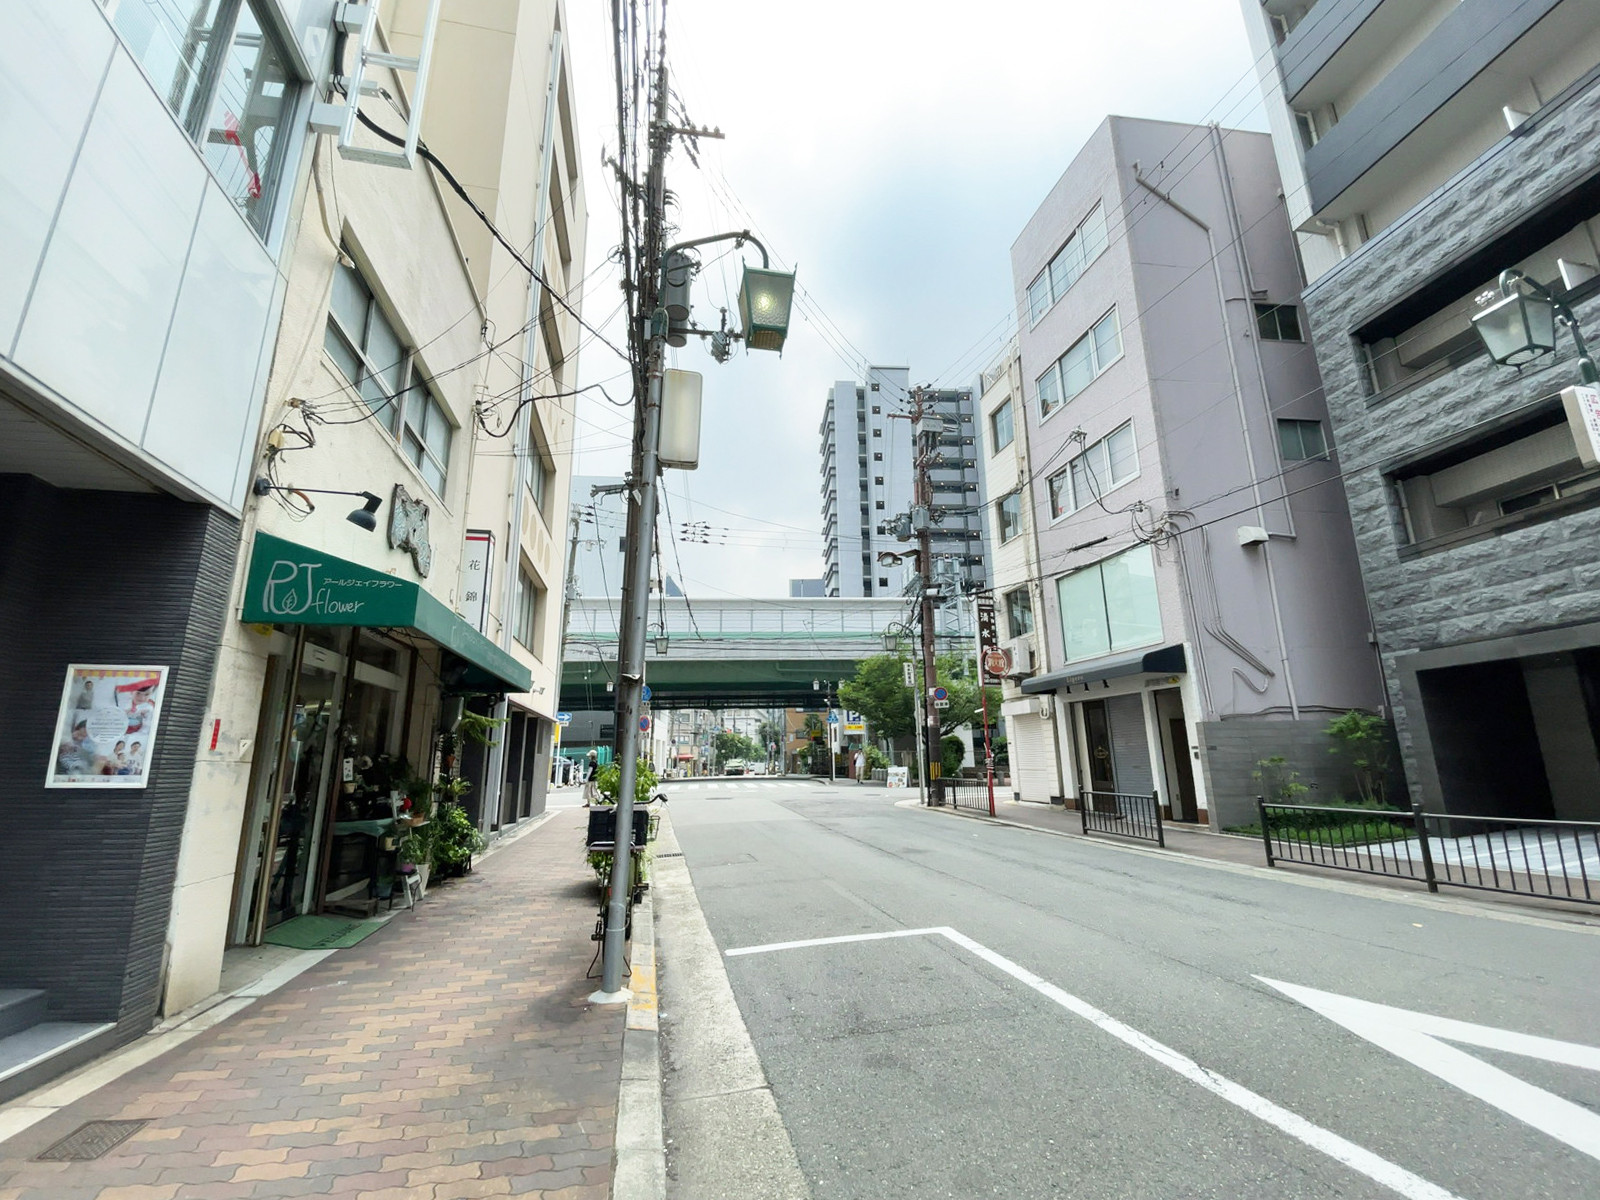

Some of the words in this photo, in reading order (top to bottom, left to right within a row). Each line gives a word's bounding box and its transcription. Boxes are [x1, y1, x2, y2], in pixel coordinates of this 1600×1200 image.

[323, 577, 403, 589] アールジェイフラワー
[465, 559, 481, 626] 花錦
[311, 588, 365, 615] flower
